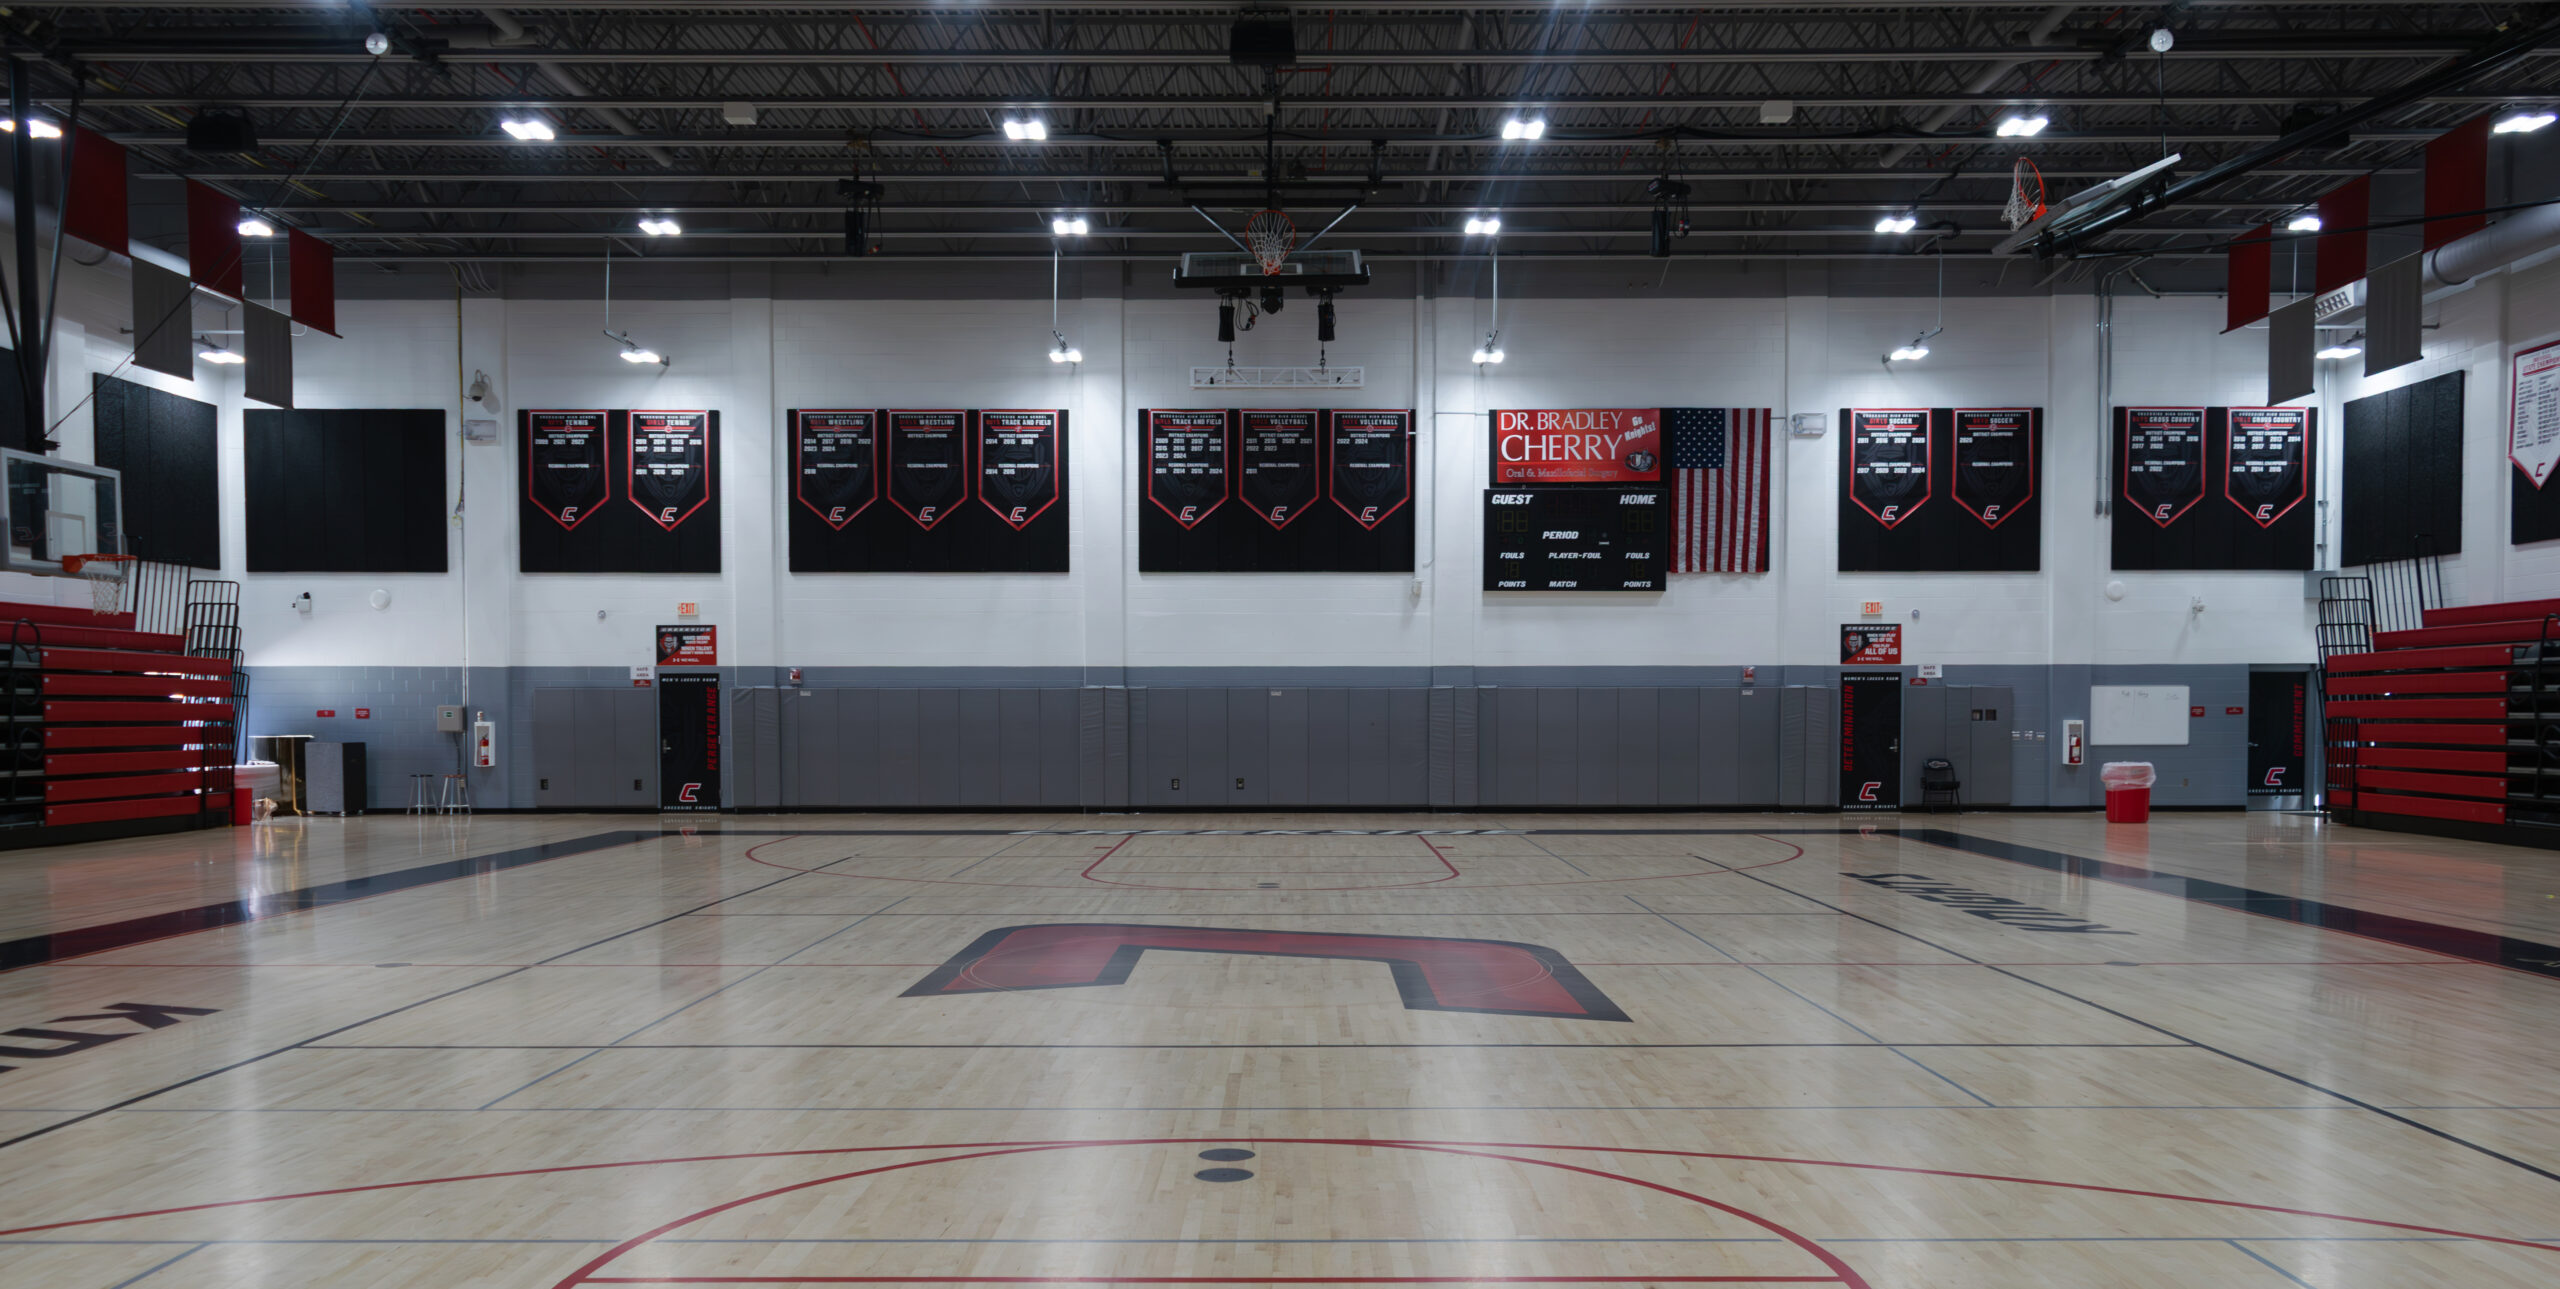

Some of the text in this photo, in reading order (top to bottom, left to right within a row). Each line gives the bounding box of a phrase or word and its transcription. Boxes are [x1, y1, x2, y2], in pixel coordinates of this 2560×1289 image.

[1501, 412, 1622, 430] DR. BRADLEY
[1632, 416, 1643, 426] Go
[1624, 422, 1656, 441] Knights!
[1501, 434, 1622, 461] CHERRY
[1506, 469, 1618, 478] Oral & Maxillofacial Surgery
[1492, 495, 1533, 505] GUEST
[1620, 495, 1656, 505] HOME
[1542, 531, 1579, 539] PERIOD
[681, 603, 694, 614] EXIT
[1866, 602, 1880, 613] EXIT
[706, 686, 717, 770] PERSEVERANCE
[1844, 685, 1854, 771] DETERMINATION
[2294, 684, 2303, 756] COMMITMENT
[2264, 767, 2286, 785] C
[679, 783, 702, 802] C
[1859, 782, 1881, 801] C
[1837, 872, 2139, 935] KNIGHTS
